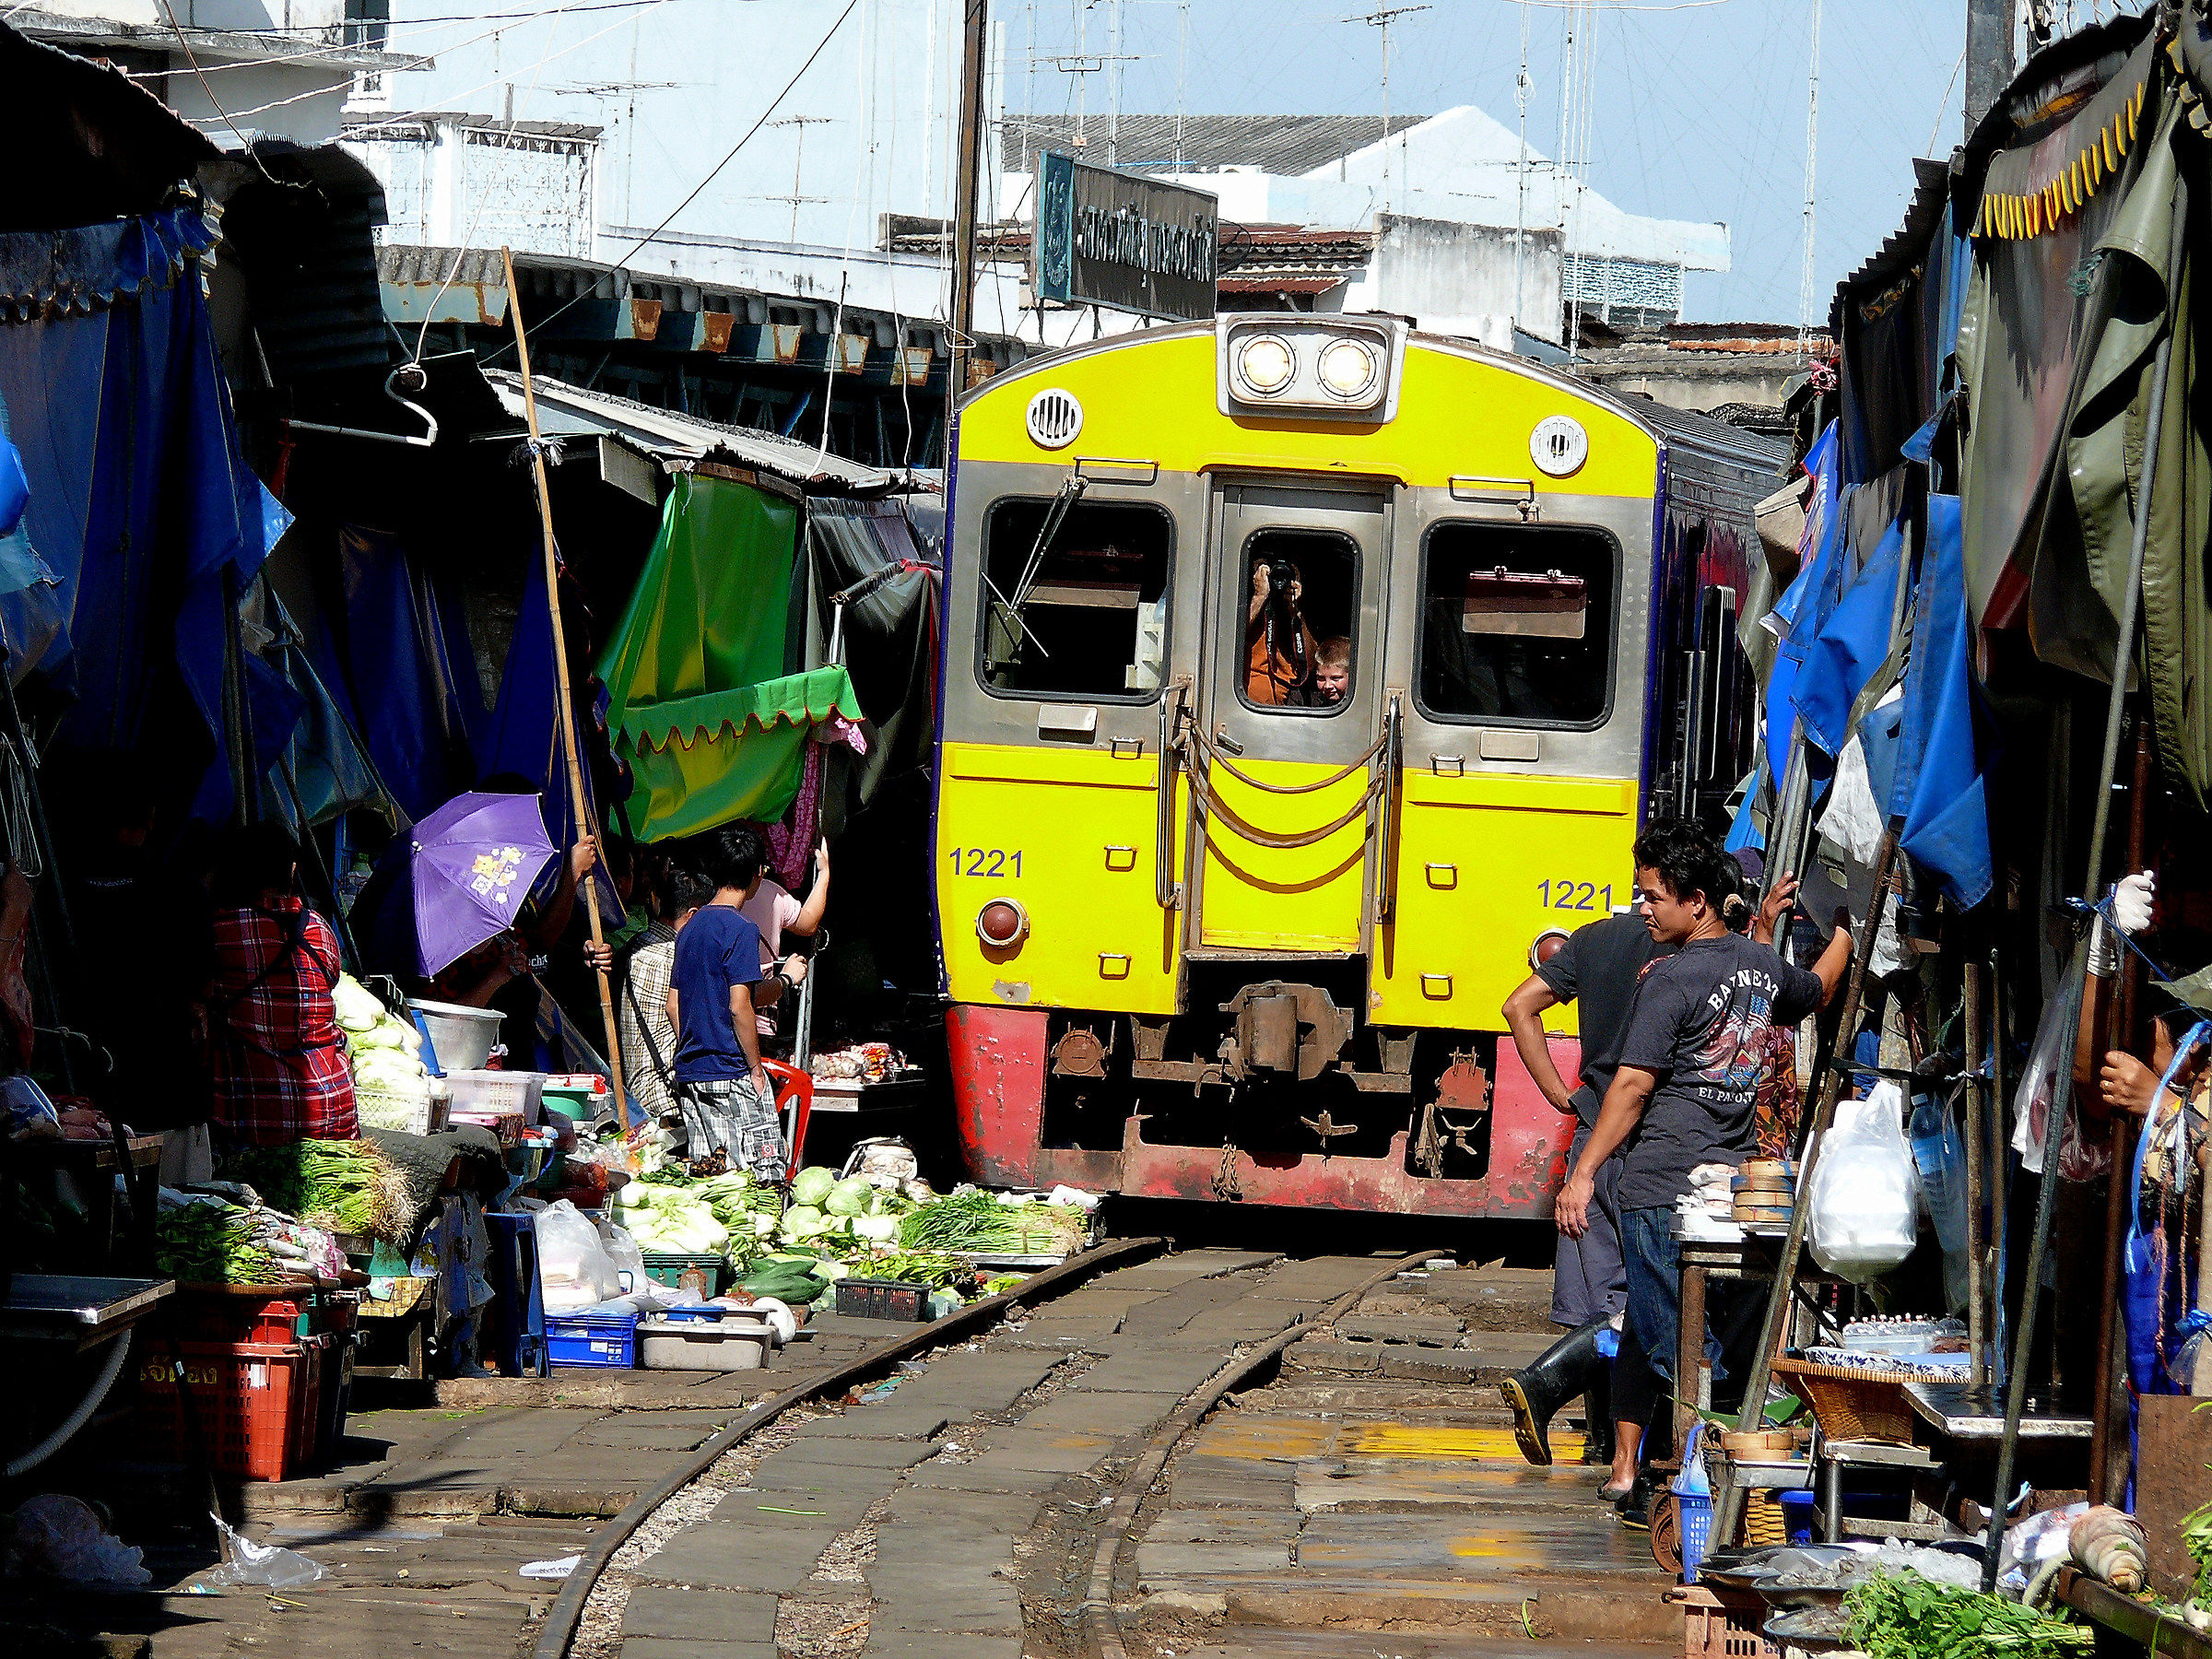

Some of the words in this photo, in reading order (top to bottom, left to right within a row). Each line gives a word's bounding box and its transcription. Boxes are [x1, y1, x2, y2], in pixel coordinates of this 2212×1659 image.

[949, 847, 1022, 877] 1221
[1537, 878, 1612, 912] 1221
[1698, 1087, 1713, 1100] EL
